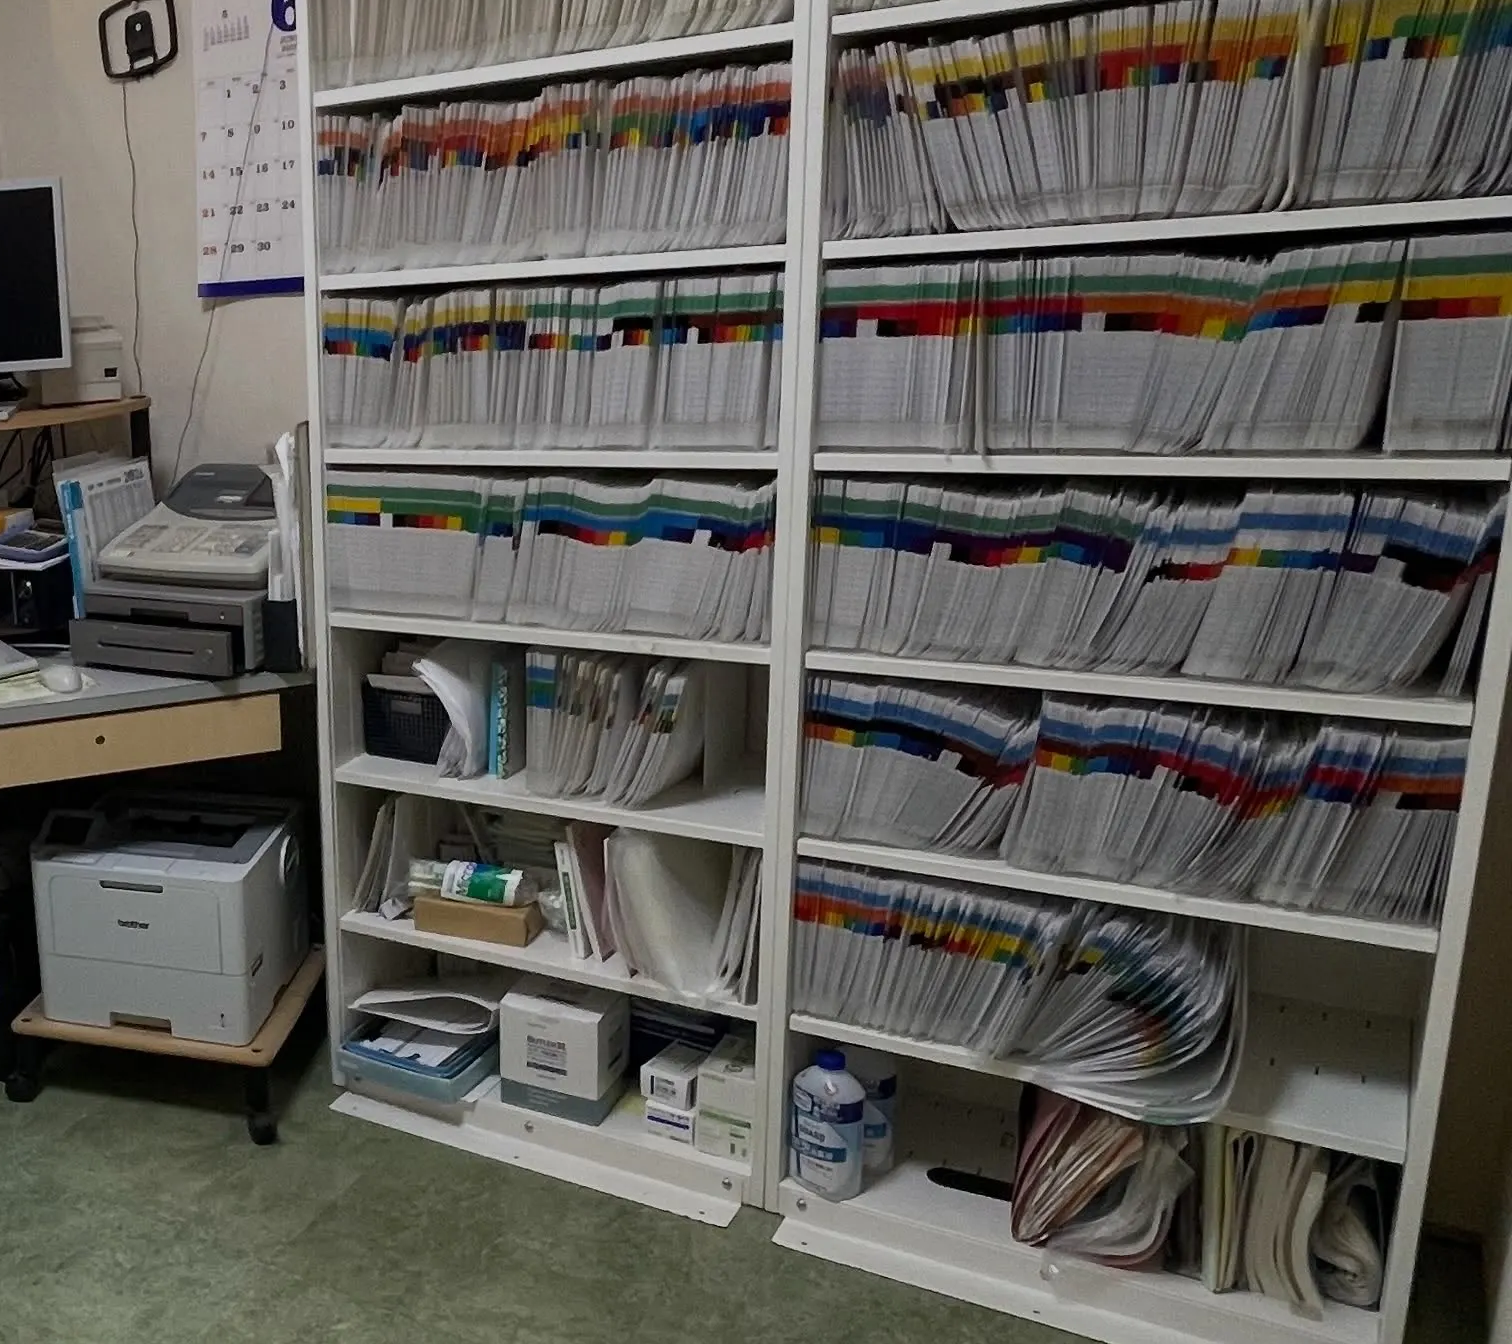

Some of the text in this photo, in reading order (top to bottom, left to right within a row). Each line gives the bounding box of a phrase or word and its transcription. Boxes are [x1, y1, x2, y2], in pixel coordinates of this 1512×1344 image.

[252, 84, 260, 94] 2
[279, 80, 286, 90] 3
[200, 131, 207, 142] 7
[227, 128, 234, 138] 8
[281, 119, 295, 131] 10
[202, 159, 295, 180] 14 15 16 17
[202, 199, 295, 218] 21 22 23 24
[202, 241, 271, 256] 28 29 30
